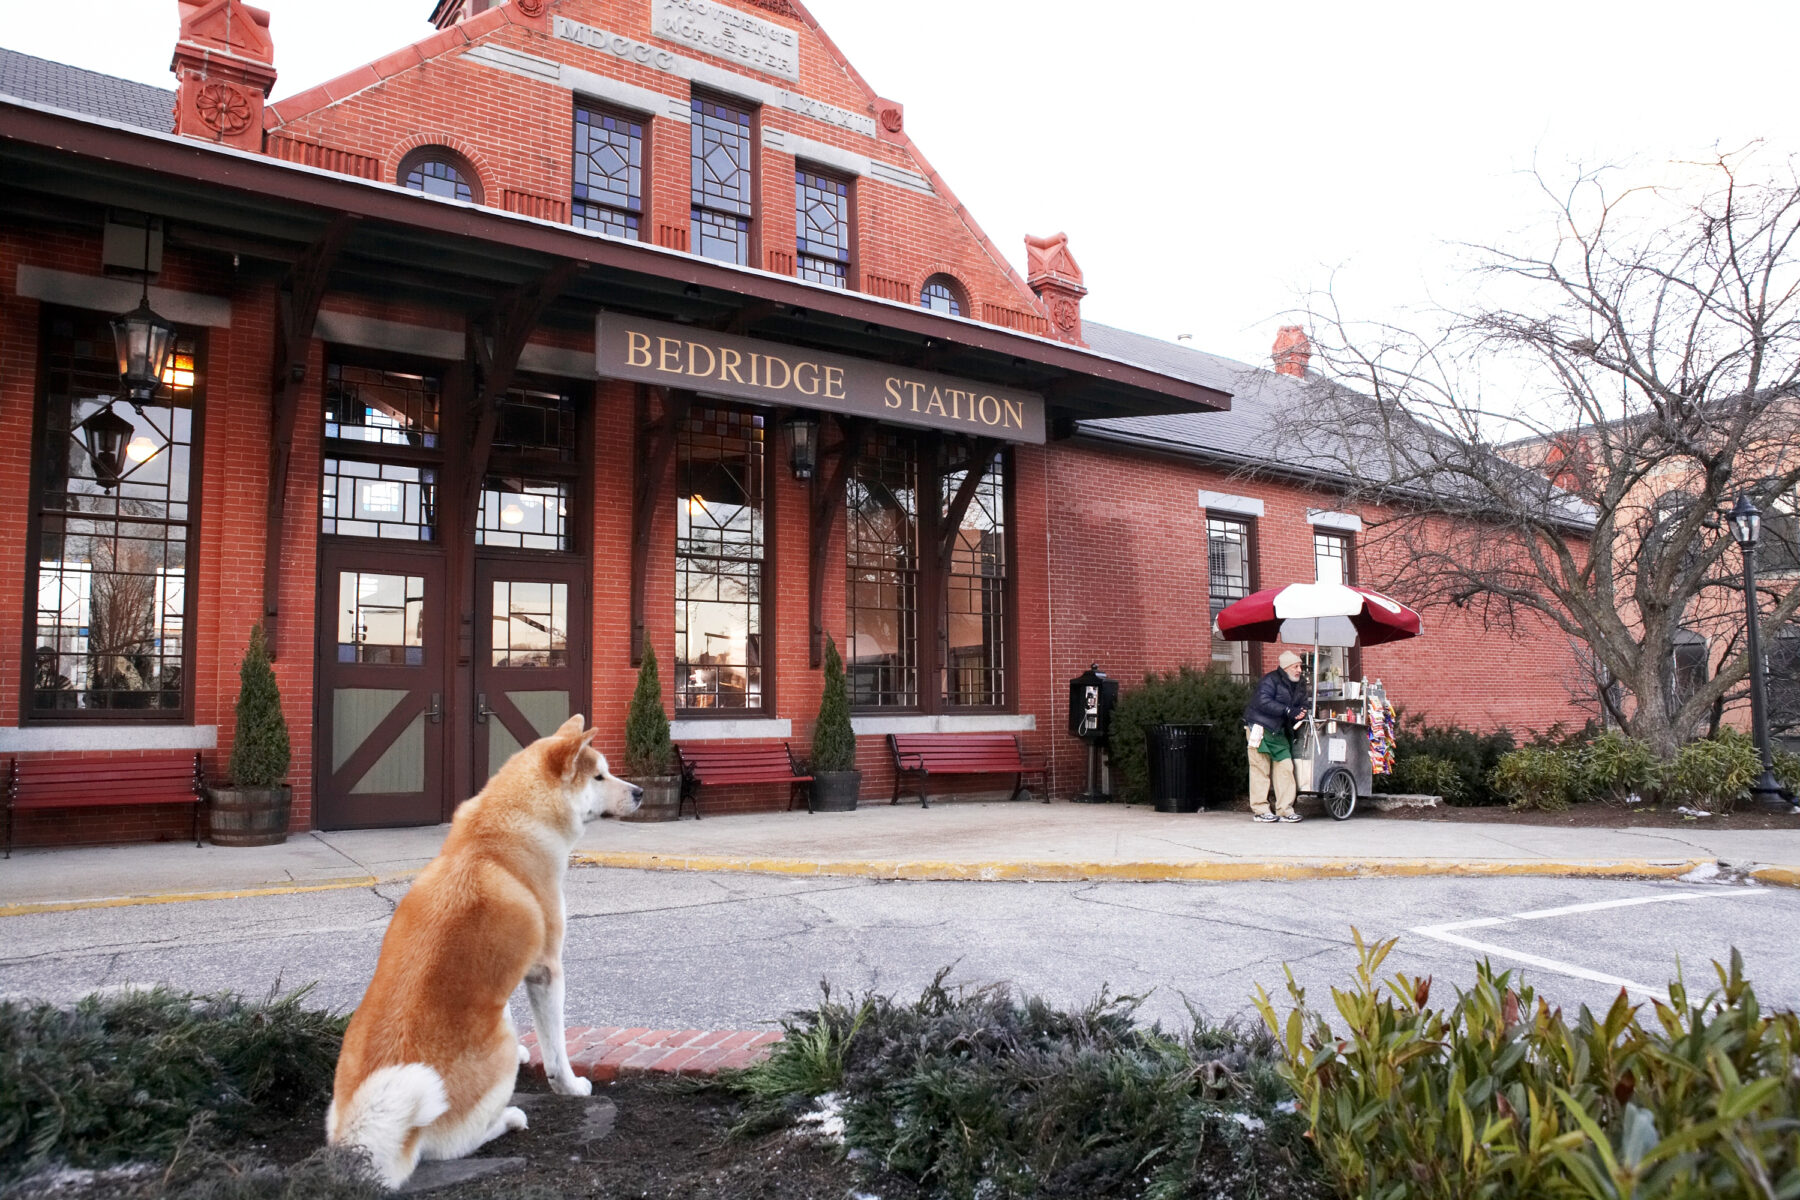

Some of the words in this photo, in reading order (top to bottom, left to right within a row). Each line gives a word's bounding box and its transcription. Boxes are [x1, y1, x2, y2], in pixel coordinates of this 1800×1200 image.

[559, 19, 673, 70] MDCCC
[662, 16, 793, 73] WORCESTER
[625, 330, 846, 400] BEDRIDGE
[884, 377, 1024, 430] STATION
